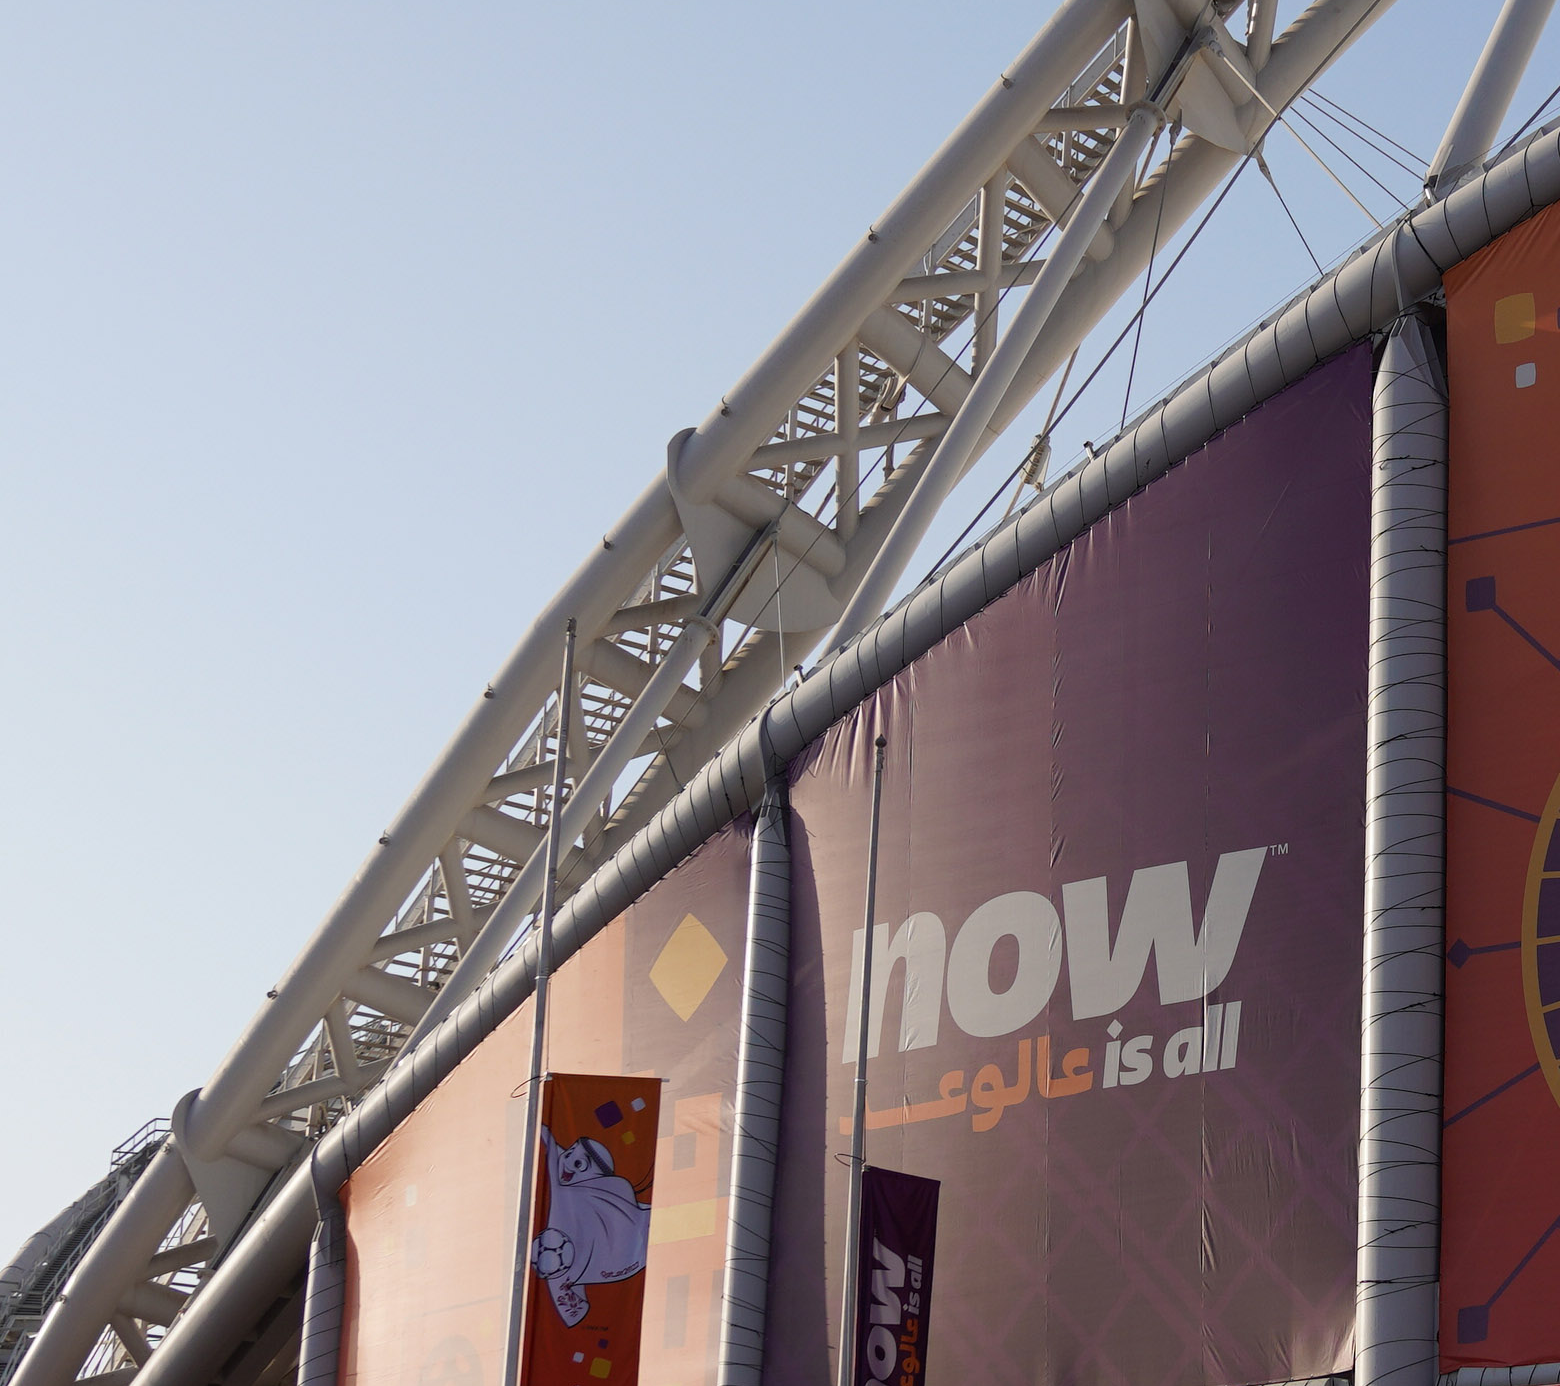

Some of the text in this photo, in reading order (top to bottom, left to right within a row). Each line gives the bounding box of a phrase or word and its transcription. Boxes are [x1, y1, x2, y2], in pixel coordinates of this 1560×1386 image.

[841, 846, 1269, 1065] now
[1103, 1001, 1243, 1089] is all
[908, 1254, 923, 1290] all
